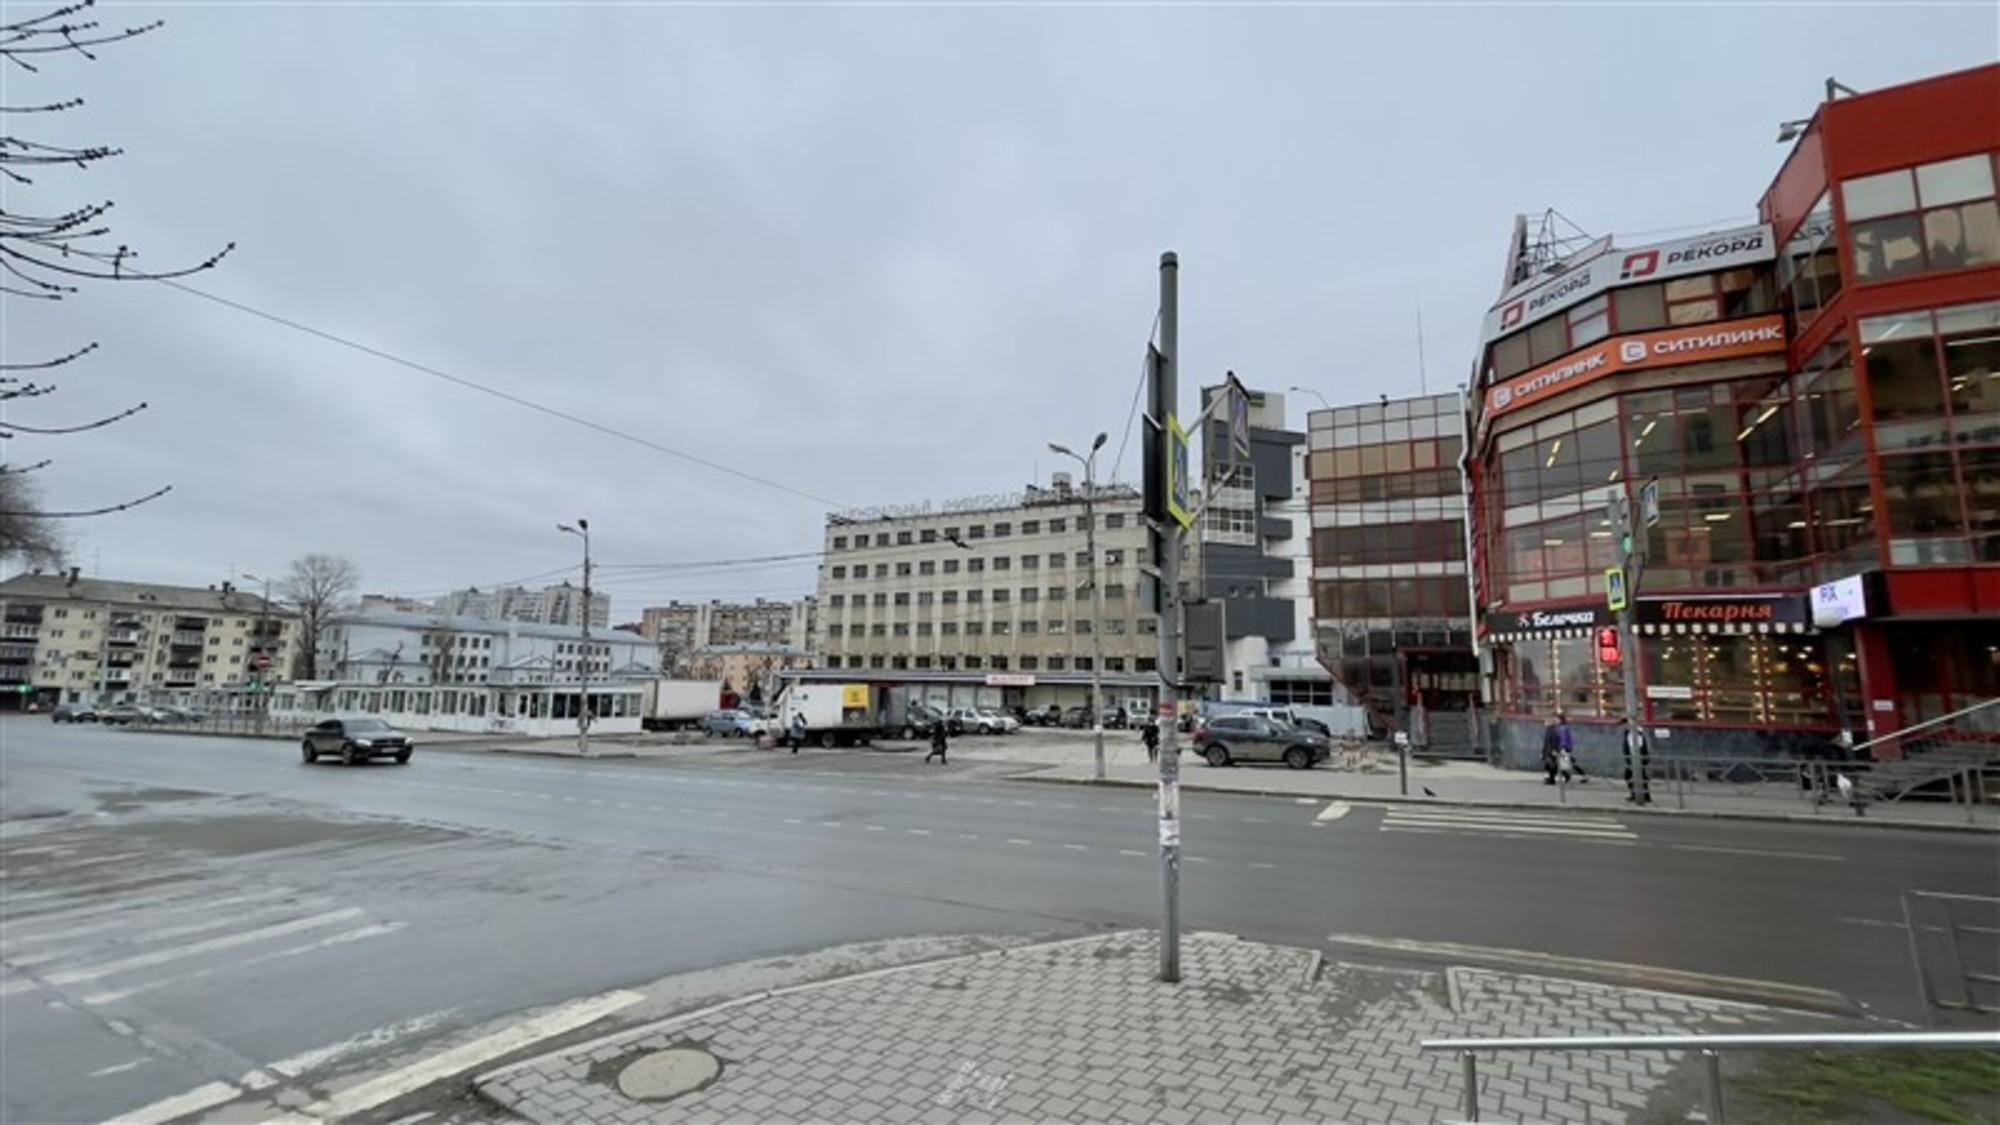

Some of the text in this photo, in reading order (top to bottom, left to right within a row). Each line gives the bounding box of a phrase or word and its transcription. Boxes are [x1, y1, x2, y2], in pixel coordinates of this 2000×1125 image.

[1667, 236, 1764, 264] РЕКОРД
[1528, 273, 1591, 312] РЕКОРД
[1653, 326, 1783, 355] СИТИЛИНК
[1513, 352, 1608, 398] СИТИЛИНК
[1531, 610, 1595, 628] Белочка
[1661, 602, 1773, 623] Пекарня
